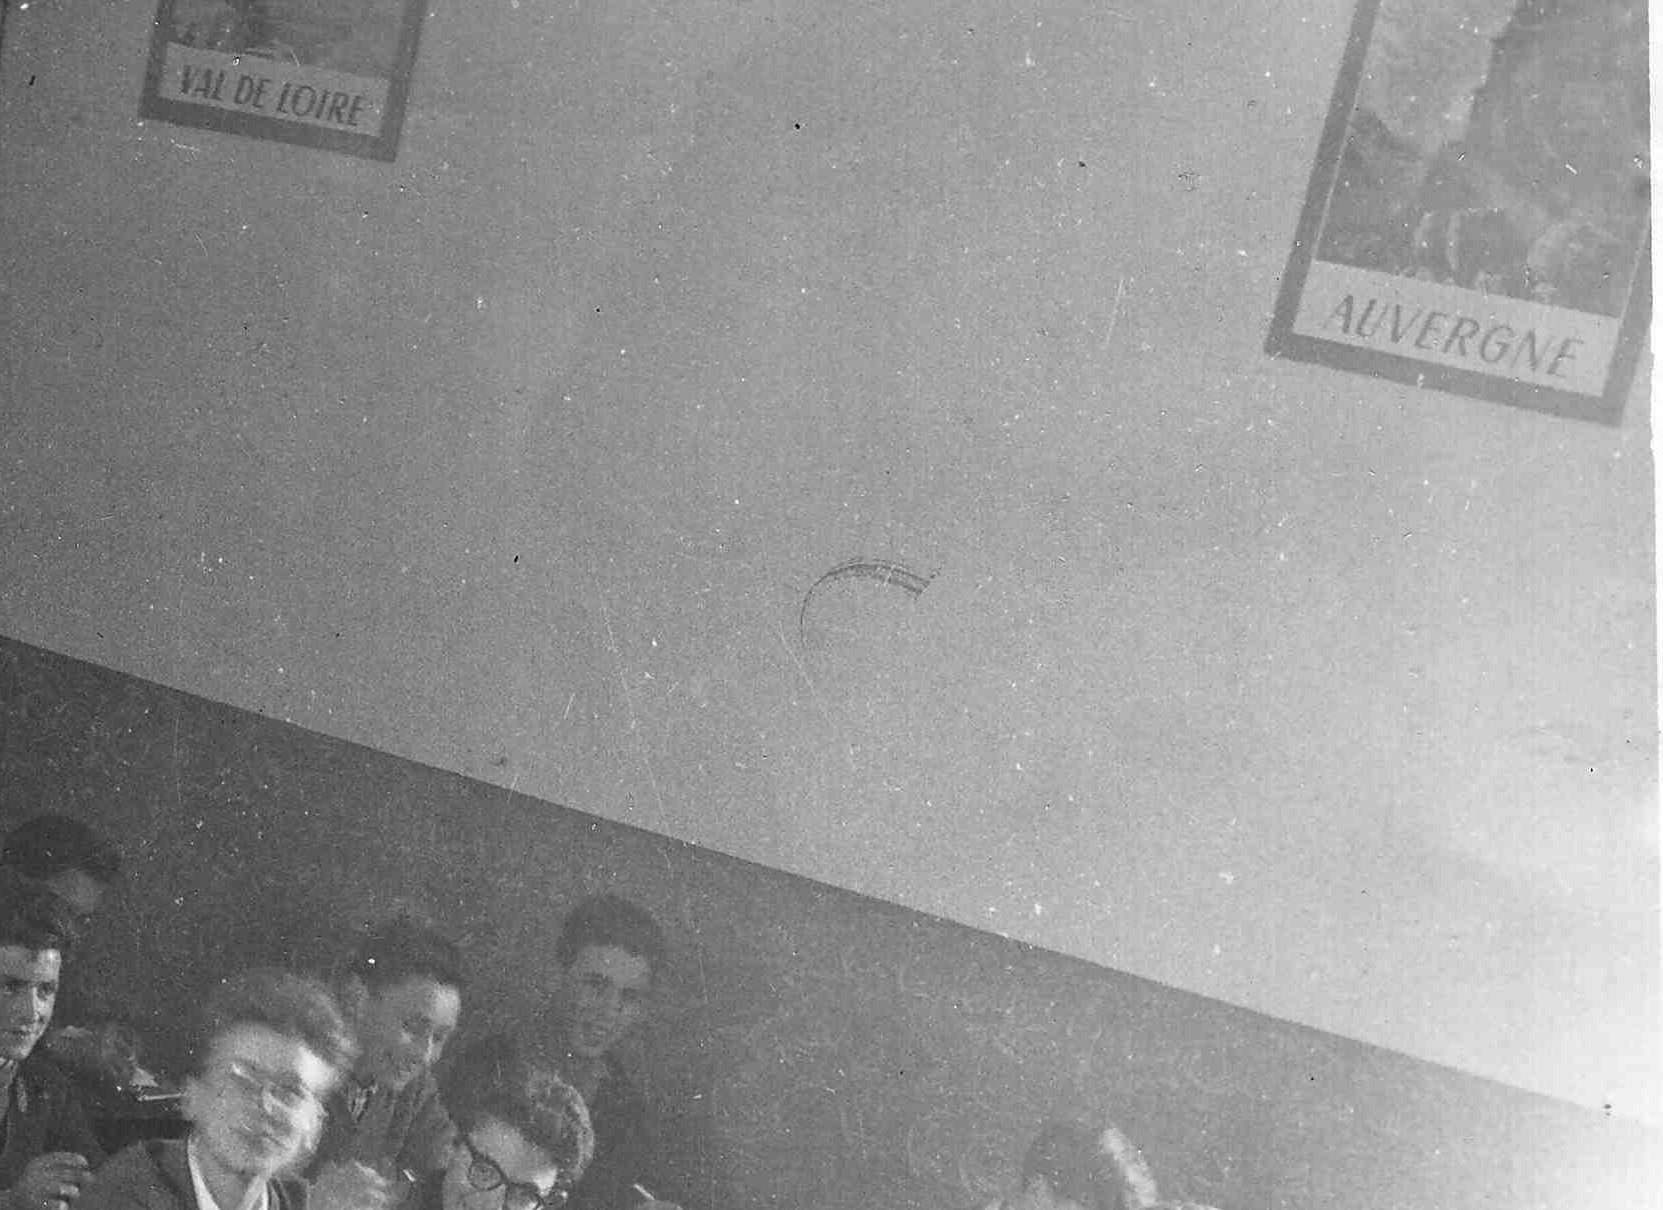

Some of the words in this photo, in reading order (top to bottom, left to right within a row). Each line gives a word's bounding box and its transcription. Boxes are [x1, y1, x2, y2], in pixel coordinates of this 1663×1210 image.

[180, 64, 226, 101] VAL
[233, 74, 272, 109] DE
[275, 81, 365, 127] LOIRE
[1329, 293, 1586, 378] AUVERGNE
